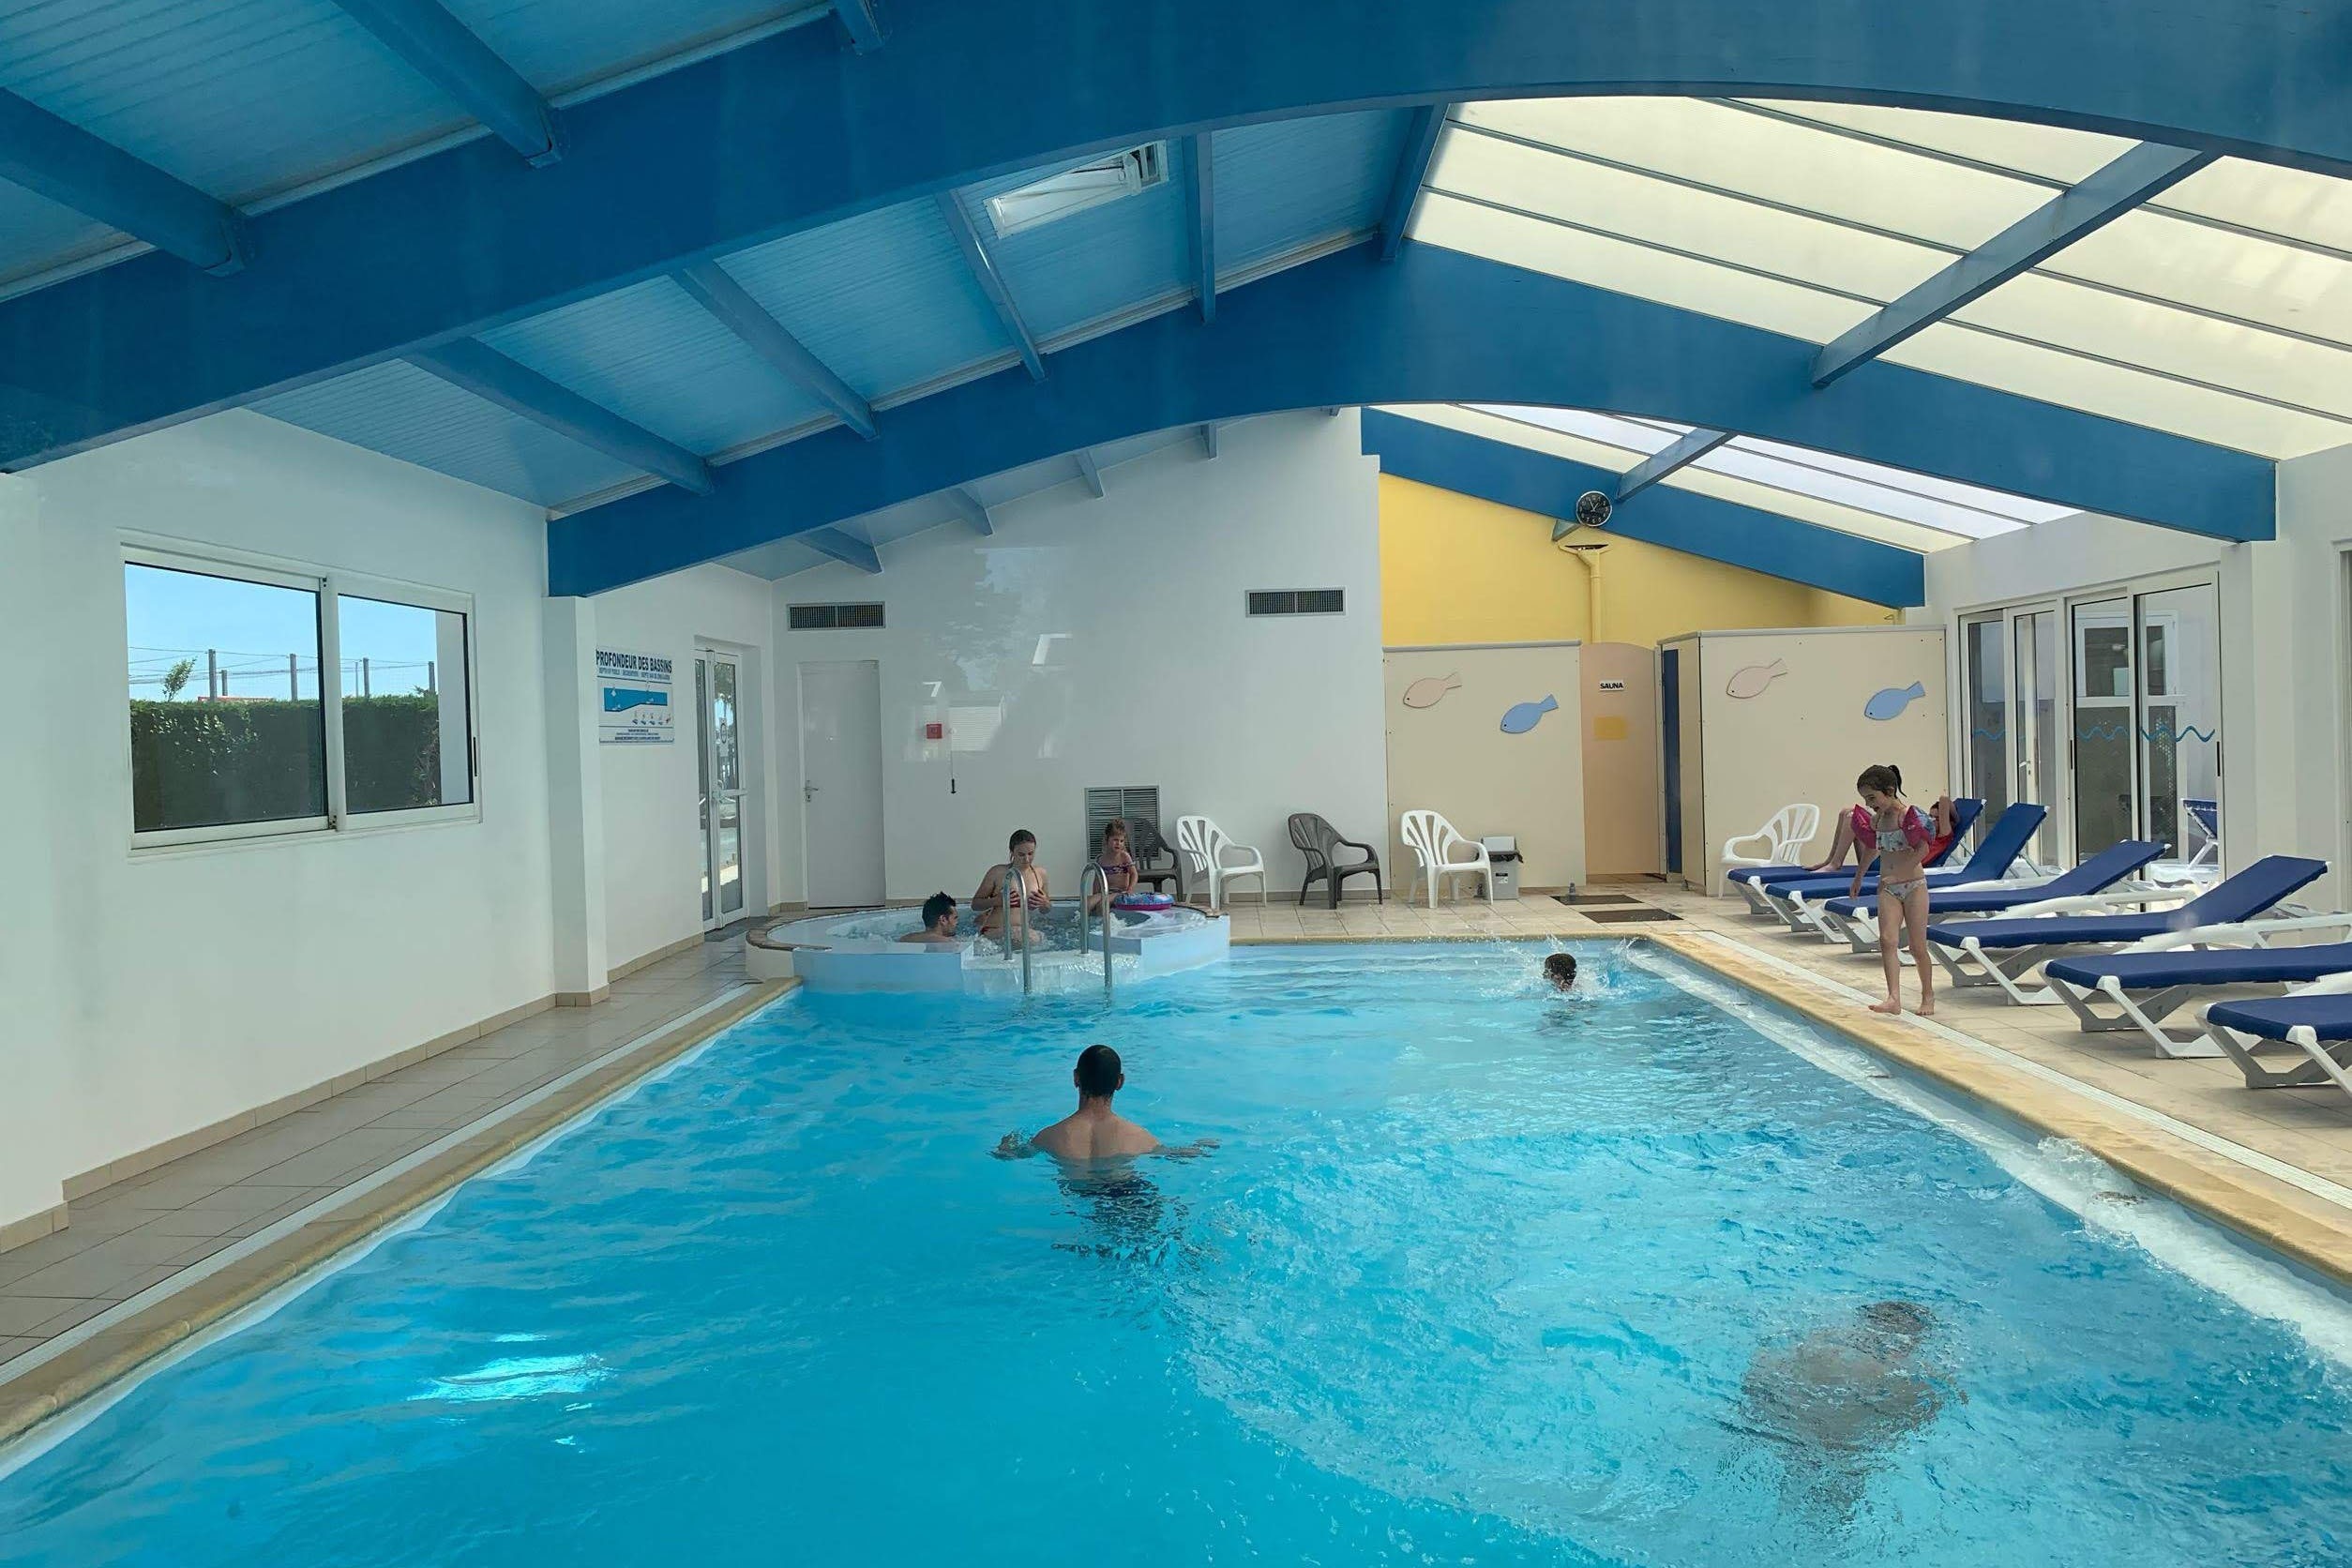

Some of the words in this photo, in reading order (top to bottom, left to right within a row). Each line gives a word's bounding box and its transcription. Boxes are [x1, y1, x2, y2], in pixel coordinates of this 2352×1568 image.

[596, 650, 637, 670] PROFONDEUR
[638, 656, 649, 671] DES
[650, 657, 672, 673] BASSINS
